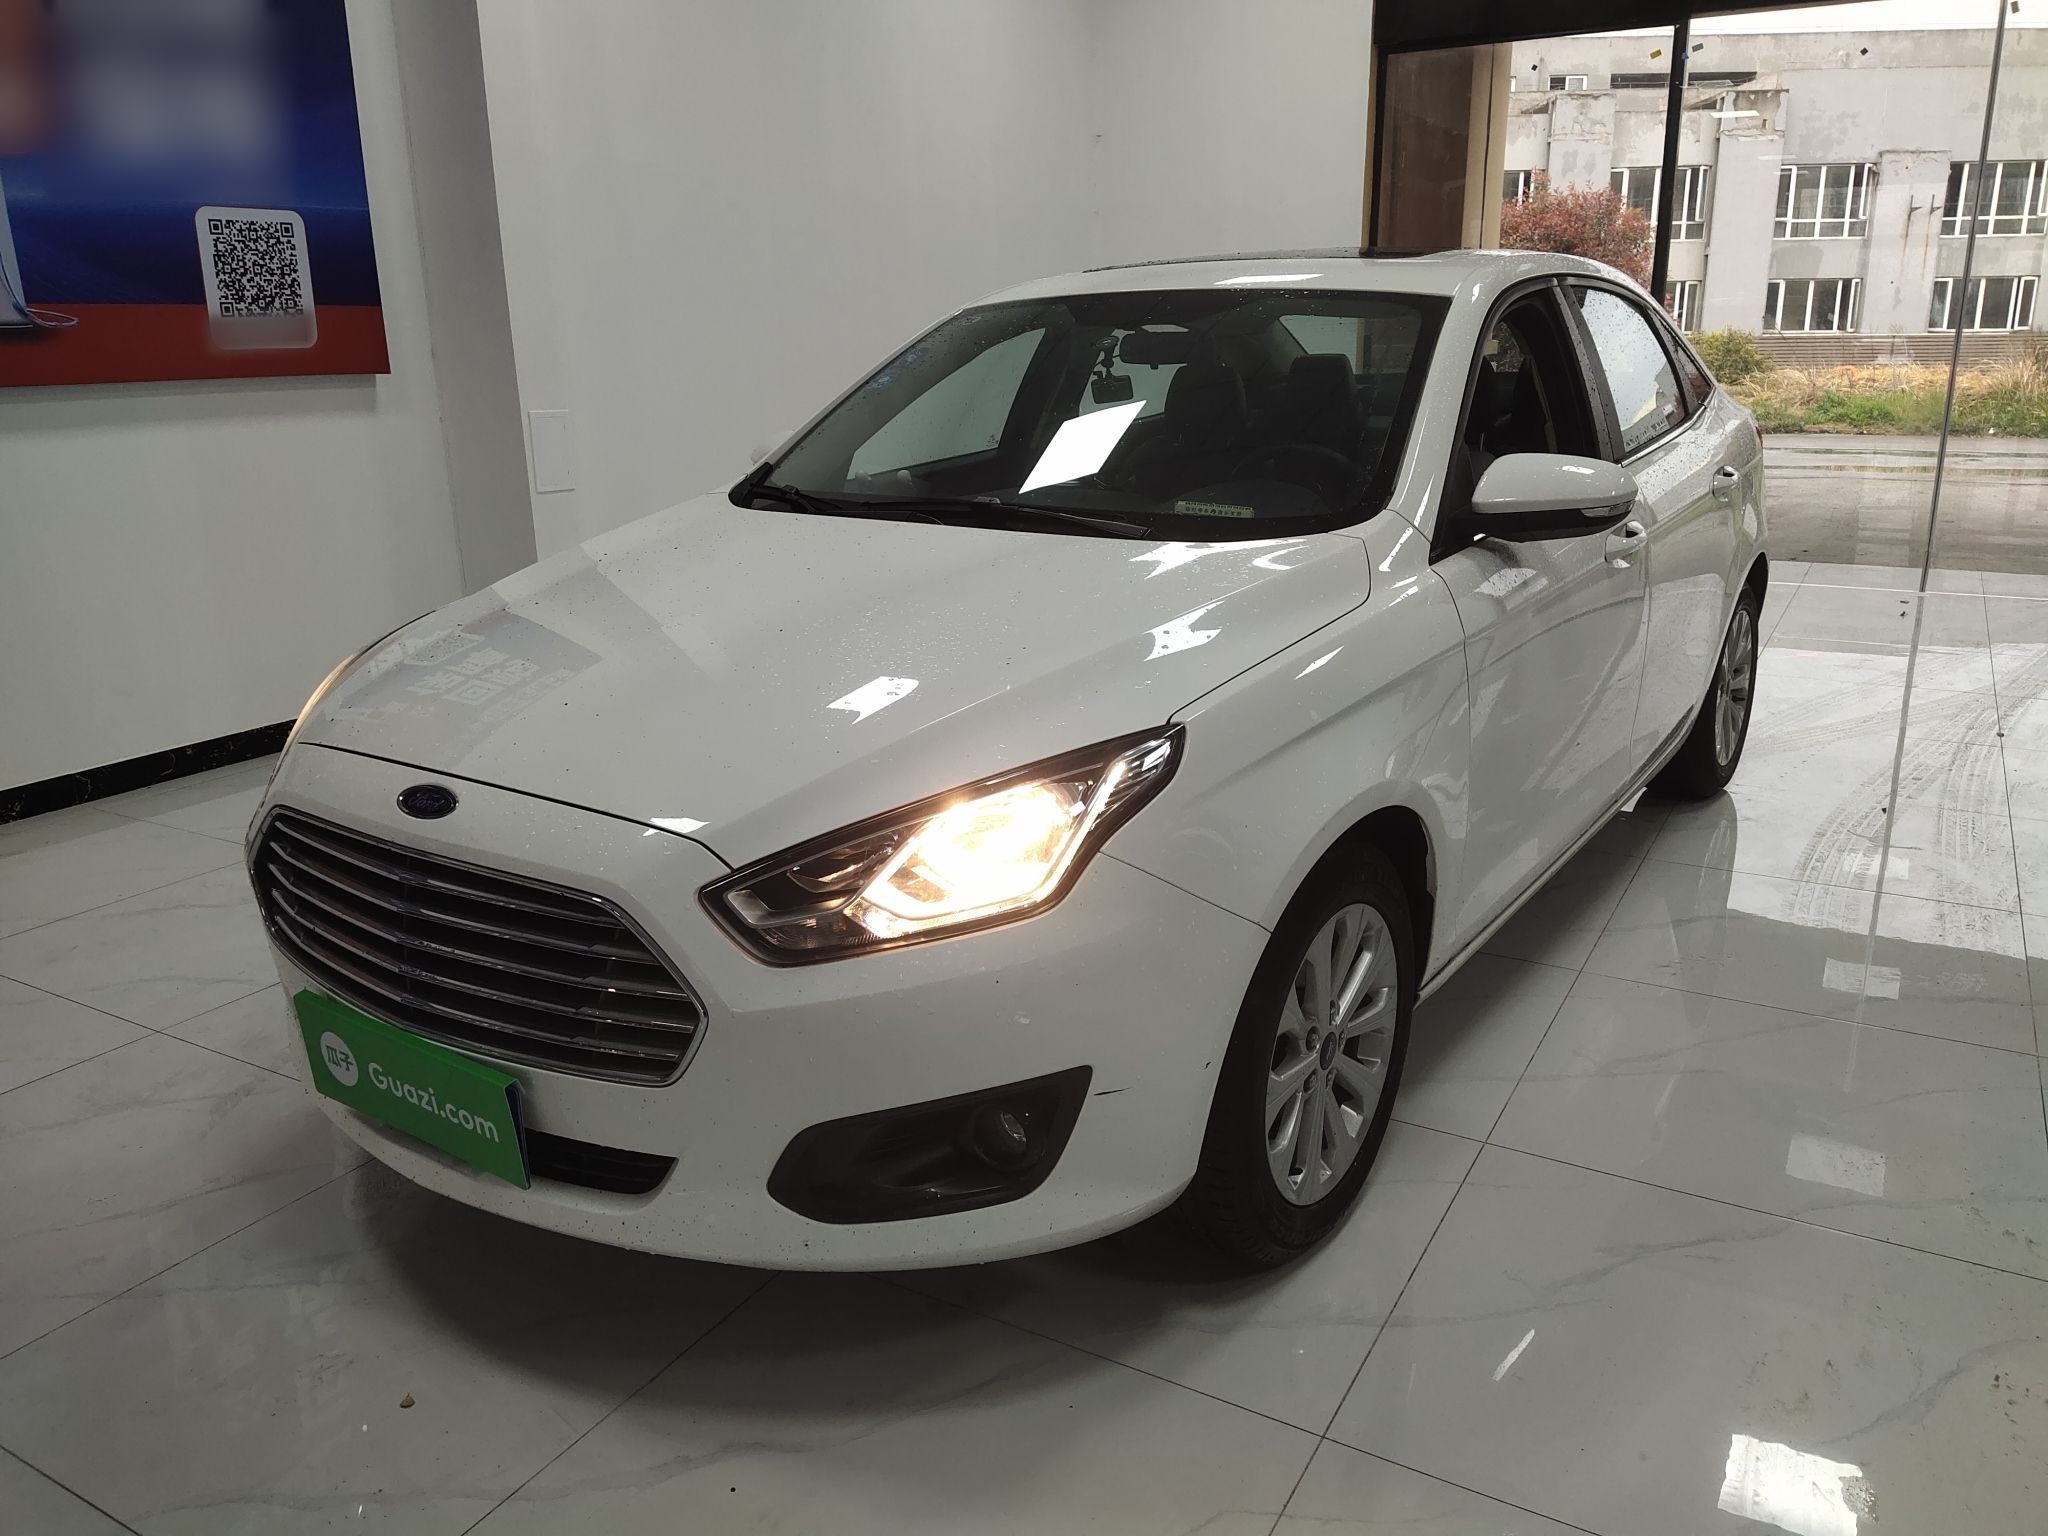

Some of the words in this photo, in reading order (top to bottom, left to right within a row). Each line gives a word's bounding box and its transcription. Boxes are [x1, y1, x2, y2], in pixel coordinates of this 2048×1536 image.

[408, 792, 446, 813] Ford
[324, 1044, 354, 1071] 瓜子
[367, 1062, 500, 1143] Guazi.com
